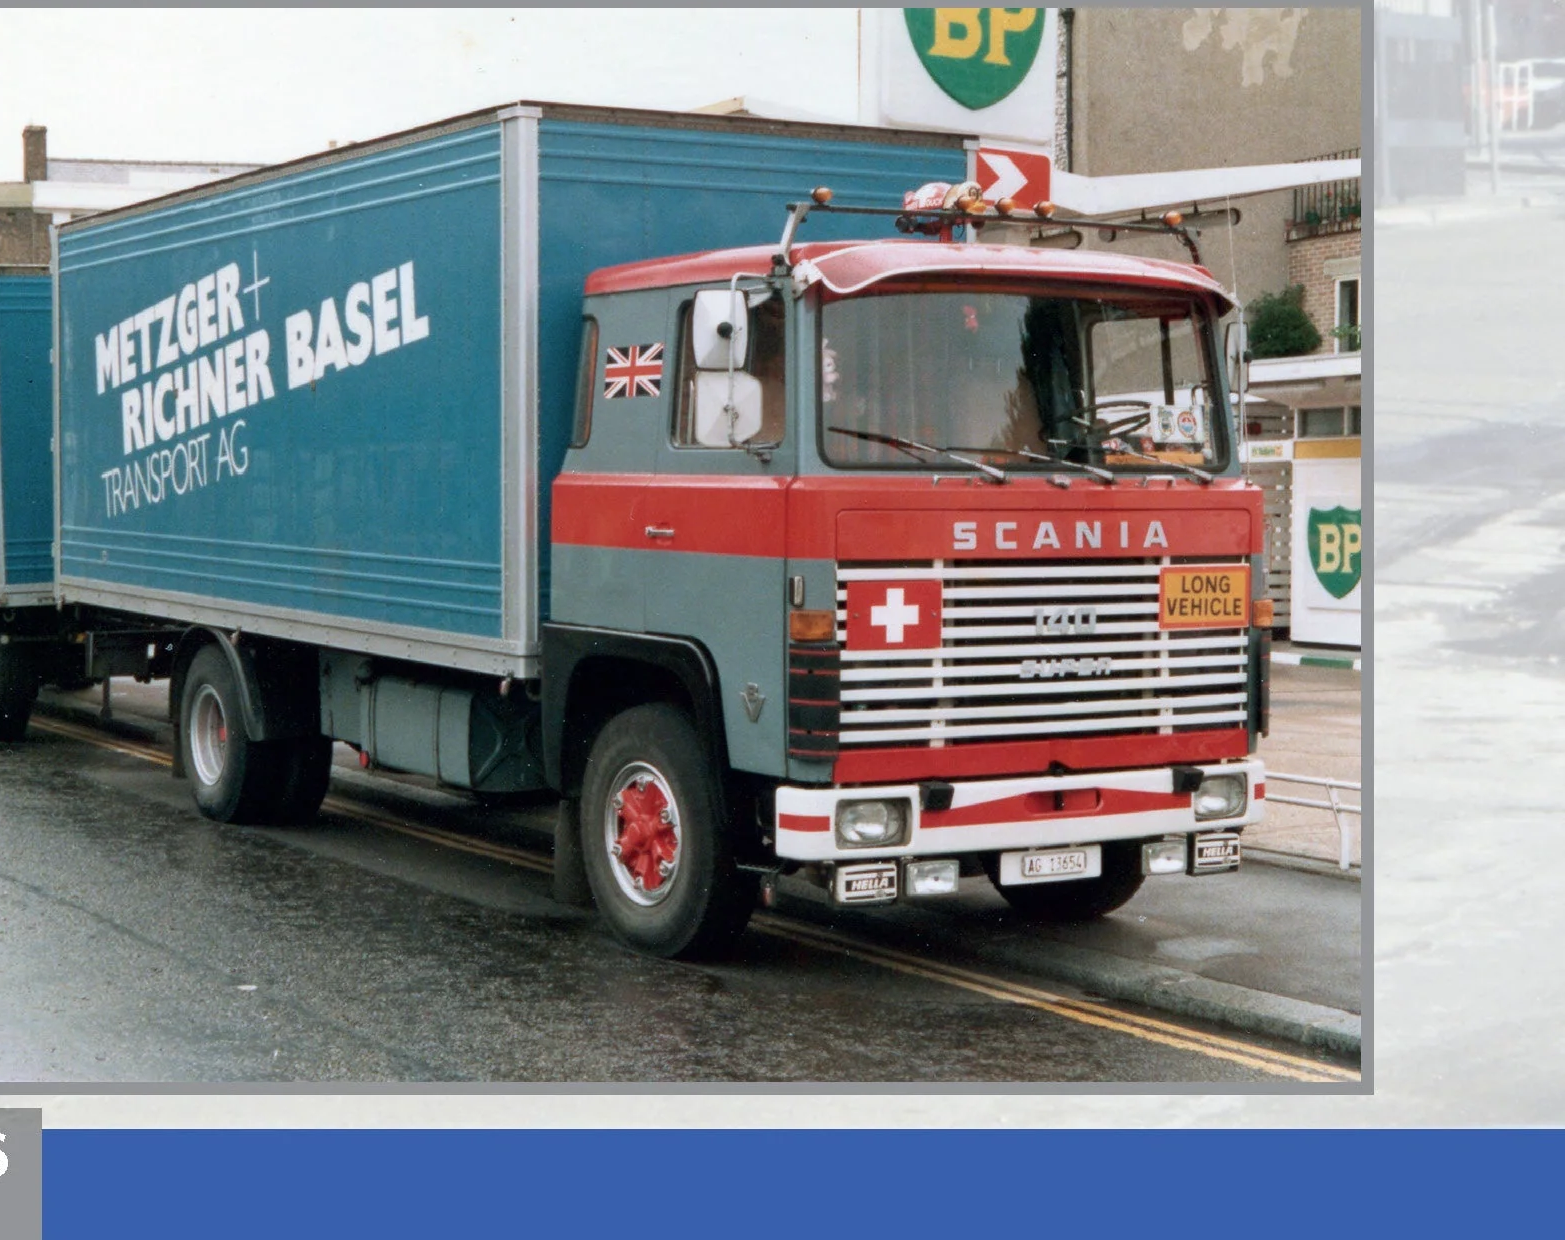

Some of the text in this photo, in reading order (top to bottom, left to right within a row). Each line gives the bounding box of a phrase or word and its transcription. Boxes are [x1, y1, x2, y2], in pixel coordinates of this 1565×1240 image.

[928, 8, 1037, 67] BP
[122, 260, 430, 455] RICHNER BASEL
[101, 420, 249, 518] TRANSPORT AG
[953, 521, 1169, 551] SCANIA
[1316, 523, 1361, 574] BP
[1181, 575, 1231, 594] LONG
[1033, 607, 1097, 635] 140
[1166, 597, 1243, 617] VEHICLE
[1028, 857, 1043, 874] AG
[1202, 845, 1234, 858] HELLA
[851, 878, 890, 891] HELLA
